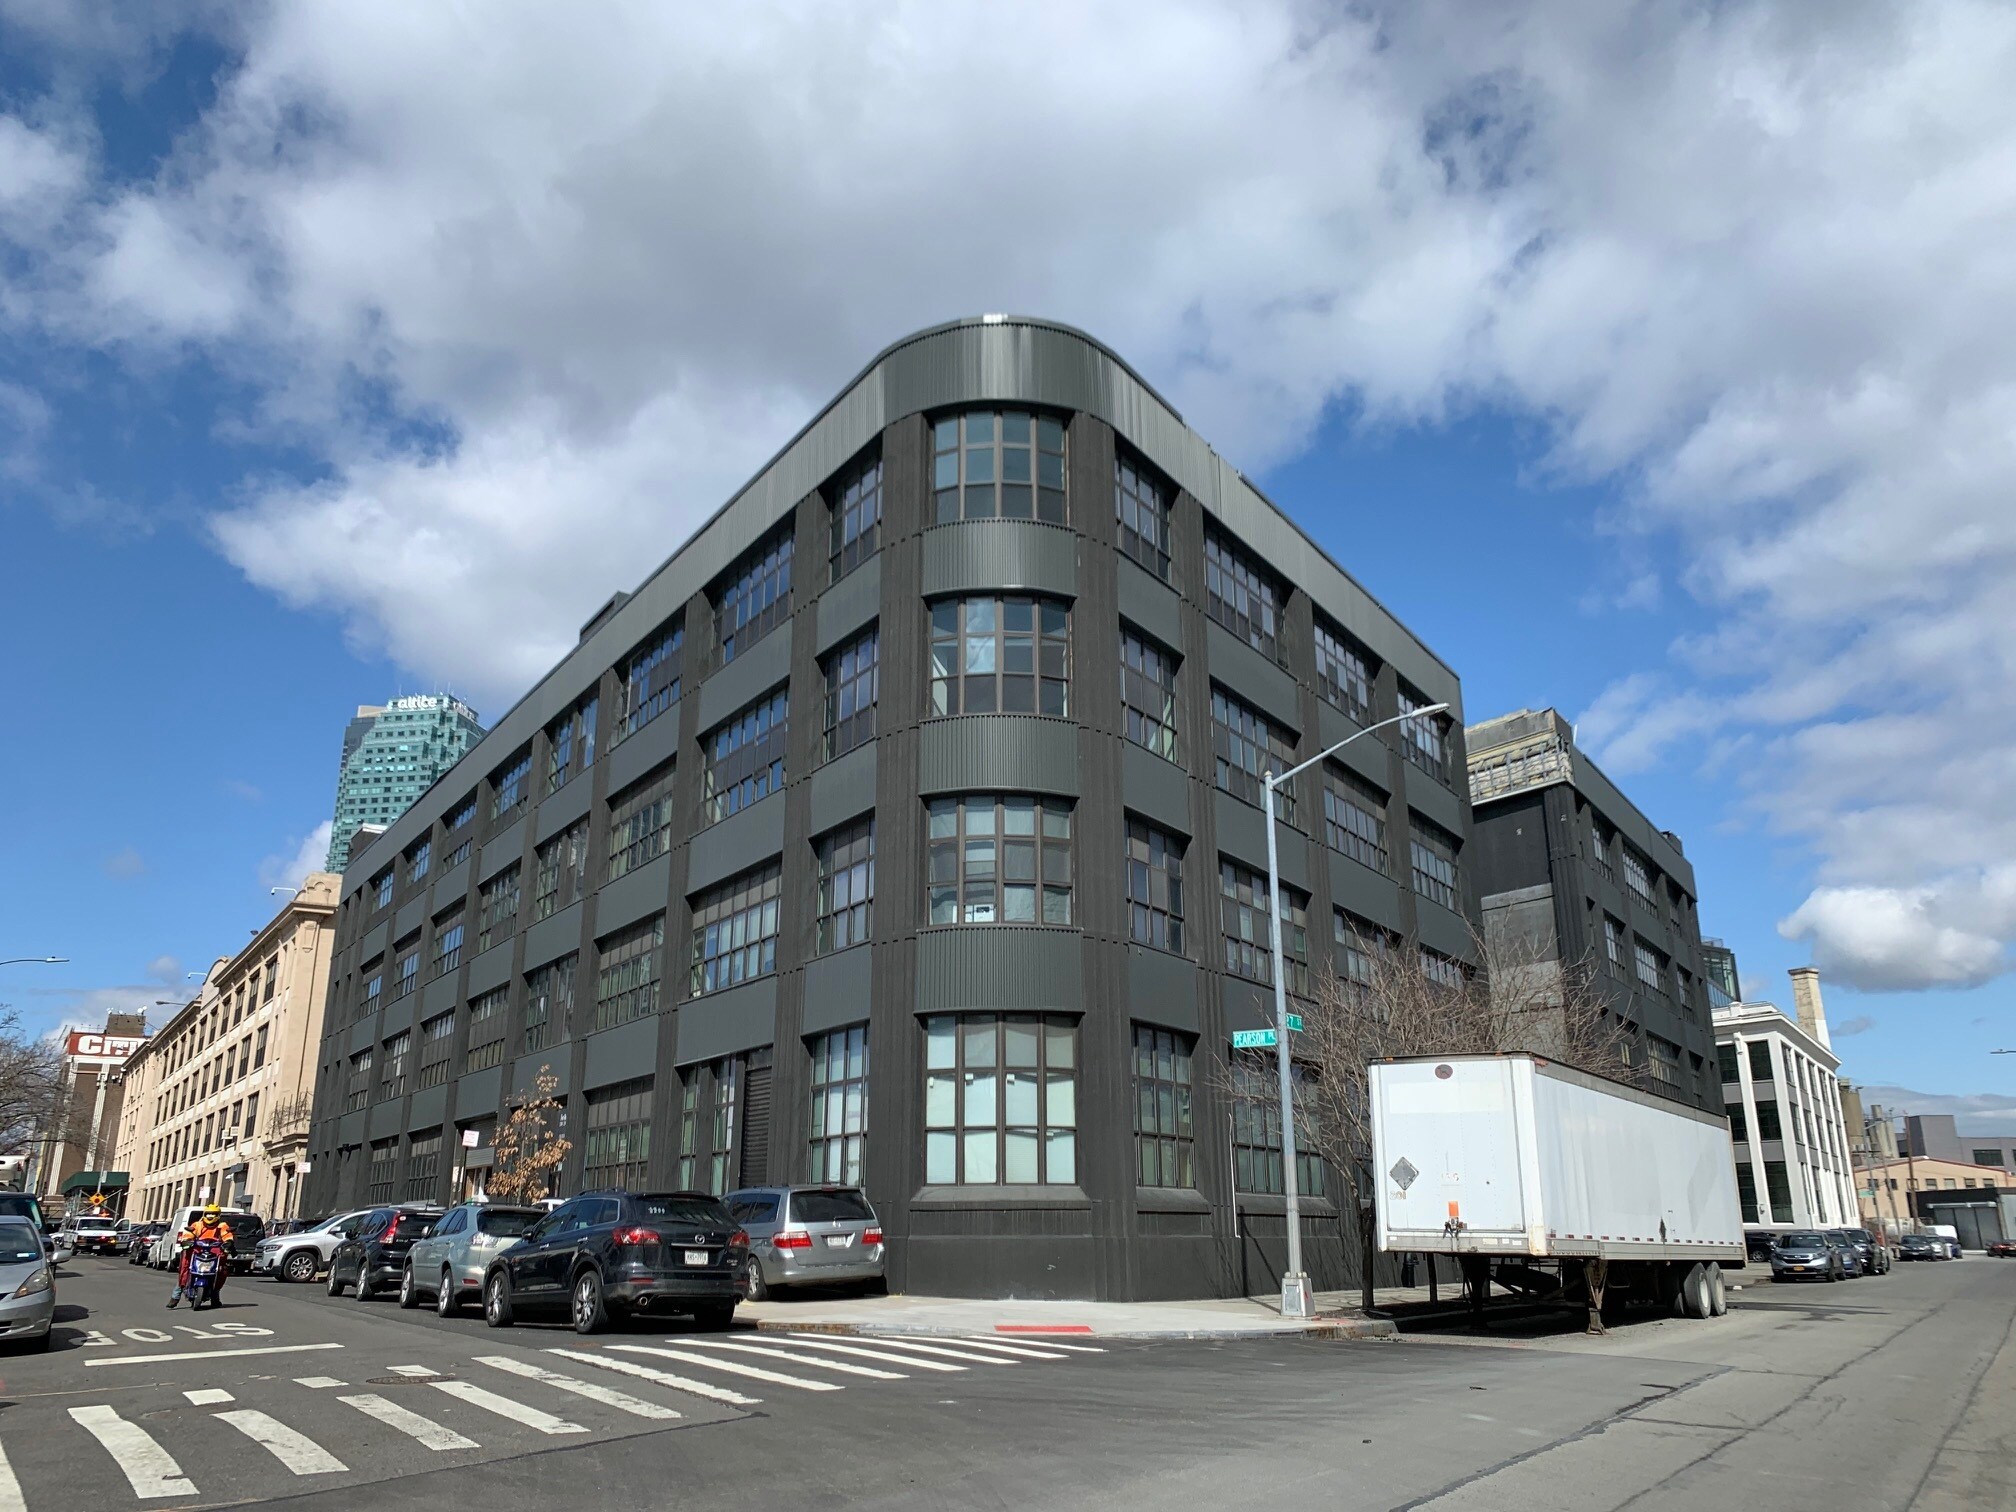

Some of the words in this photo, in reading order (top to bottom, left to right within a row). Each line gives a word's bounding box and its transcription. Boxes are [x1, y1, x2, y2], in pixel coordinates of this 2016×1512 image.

[398, 695, 438, 709] altice
[1234, 1032, 1266, 1046] PEARSON
[70, 1322, 275, 1347] STOP
